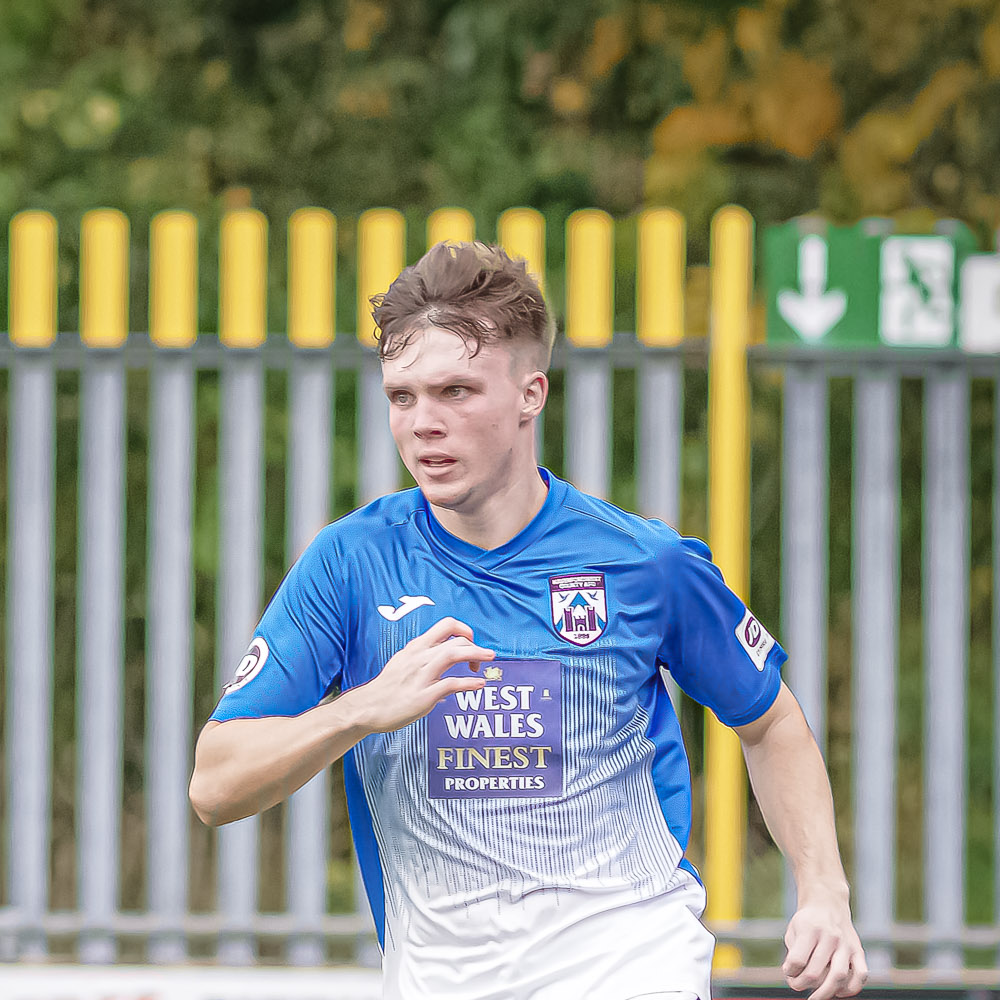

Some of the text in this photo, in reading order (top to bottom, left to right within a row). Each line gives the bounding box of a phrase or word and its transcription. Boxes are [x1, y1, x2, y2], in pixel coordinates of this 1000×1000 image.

[454, 685, 535, 712] WEST
[443, 713, 544, 739] WALES
[436, 746, 552, 770] FINEST
[444, 776, 545, 791] PROPERTIES
